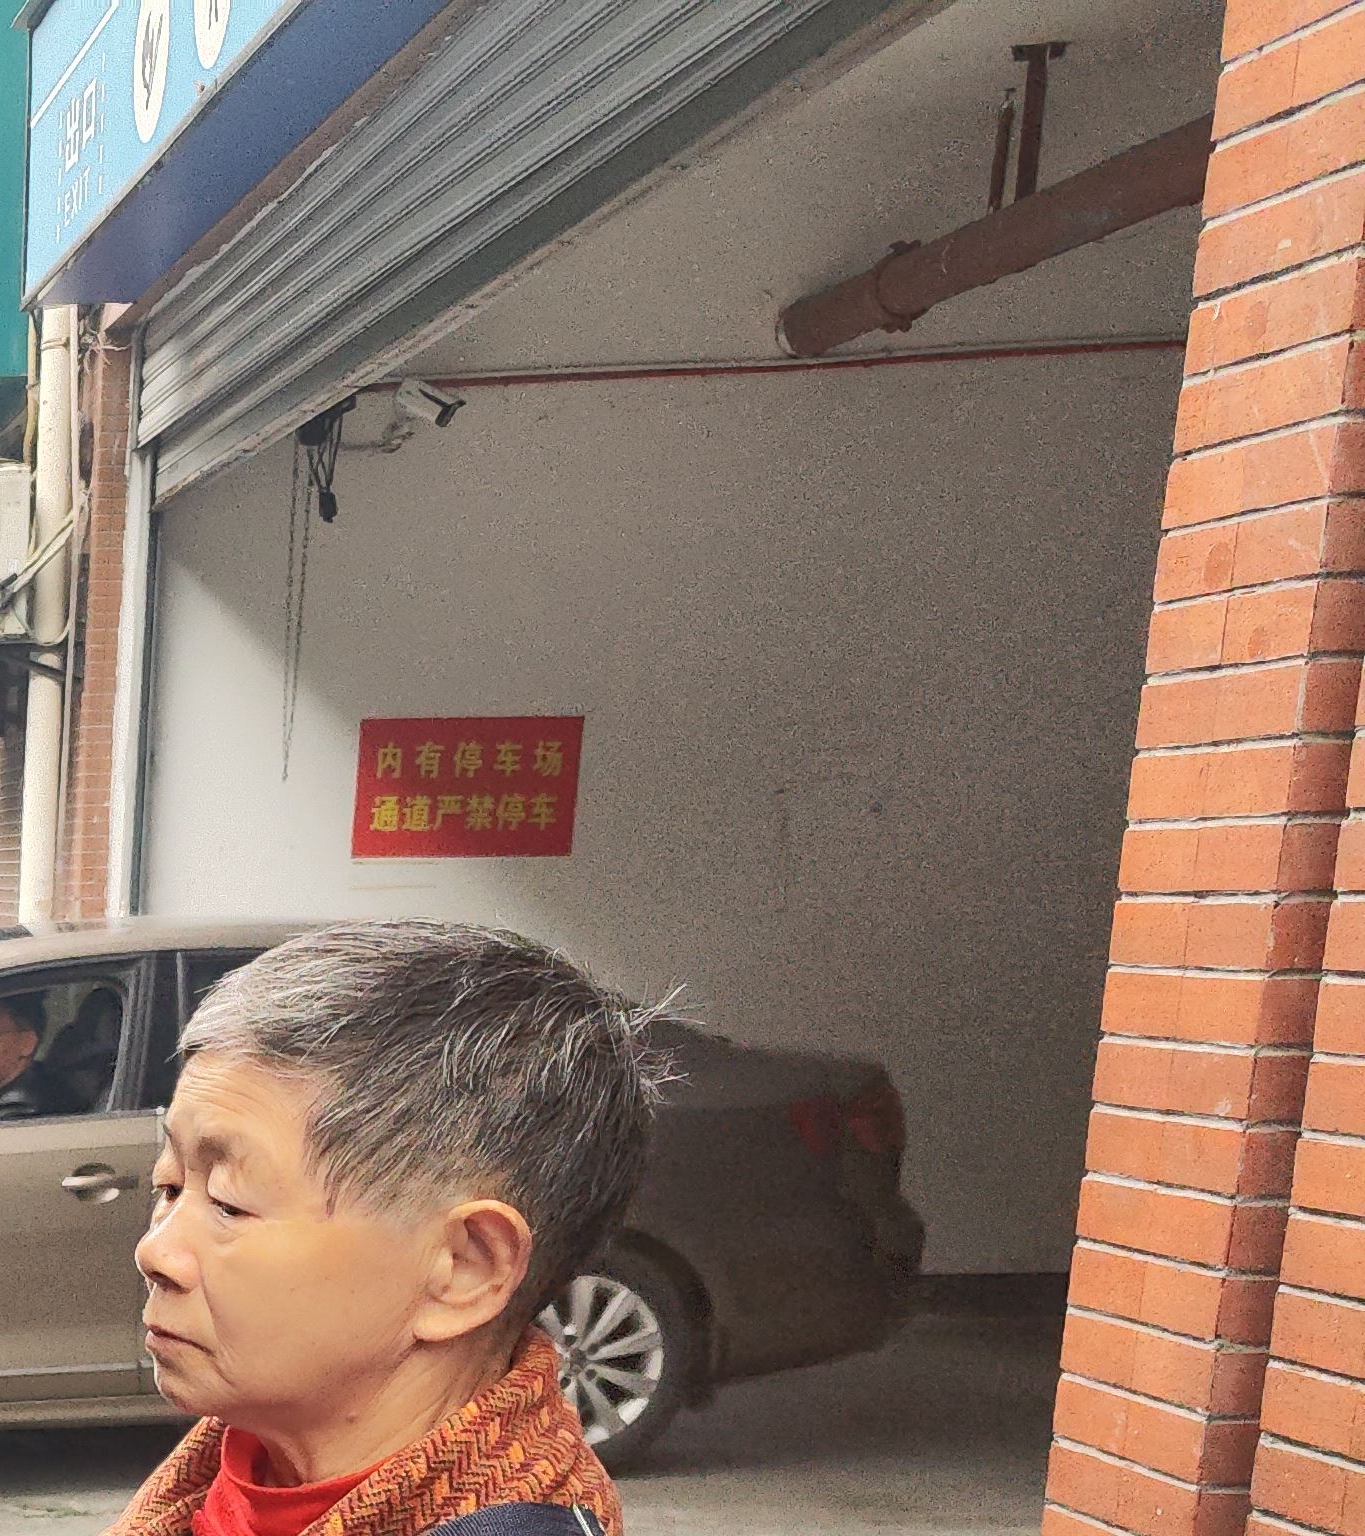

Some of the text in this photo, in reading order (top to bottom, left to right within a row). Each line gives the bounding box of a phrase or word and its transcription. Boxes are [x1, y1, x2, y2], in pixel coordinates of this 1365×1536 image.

[64, 77, 97, 172] 出口
[64, 166, 91, 228] EXIT
[375, 740, 564, 778] 内有停车场
[369, 793, 558, 832] 通道严禁停车
